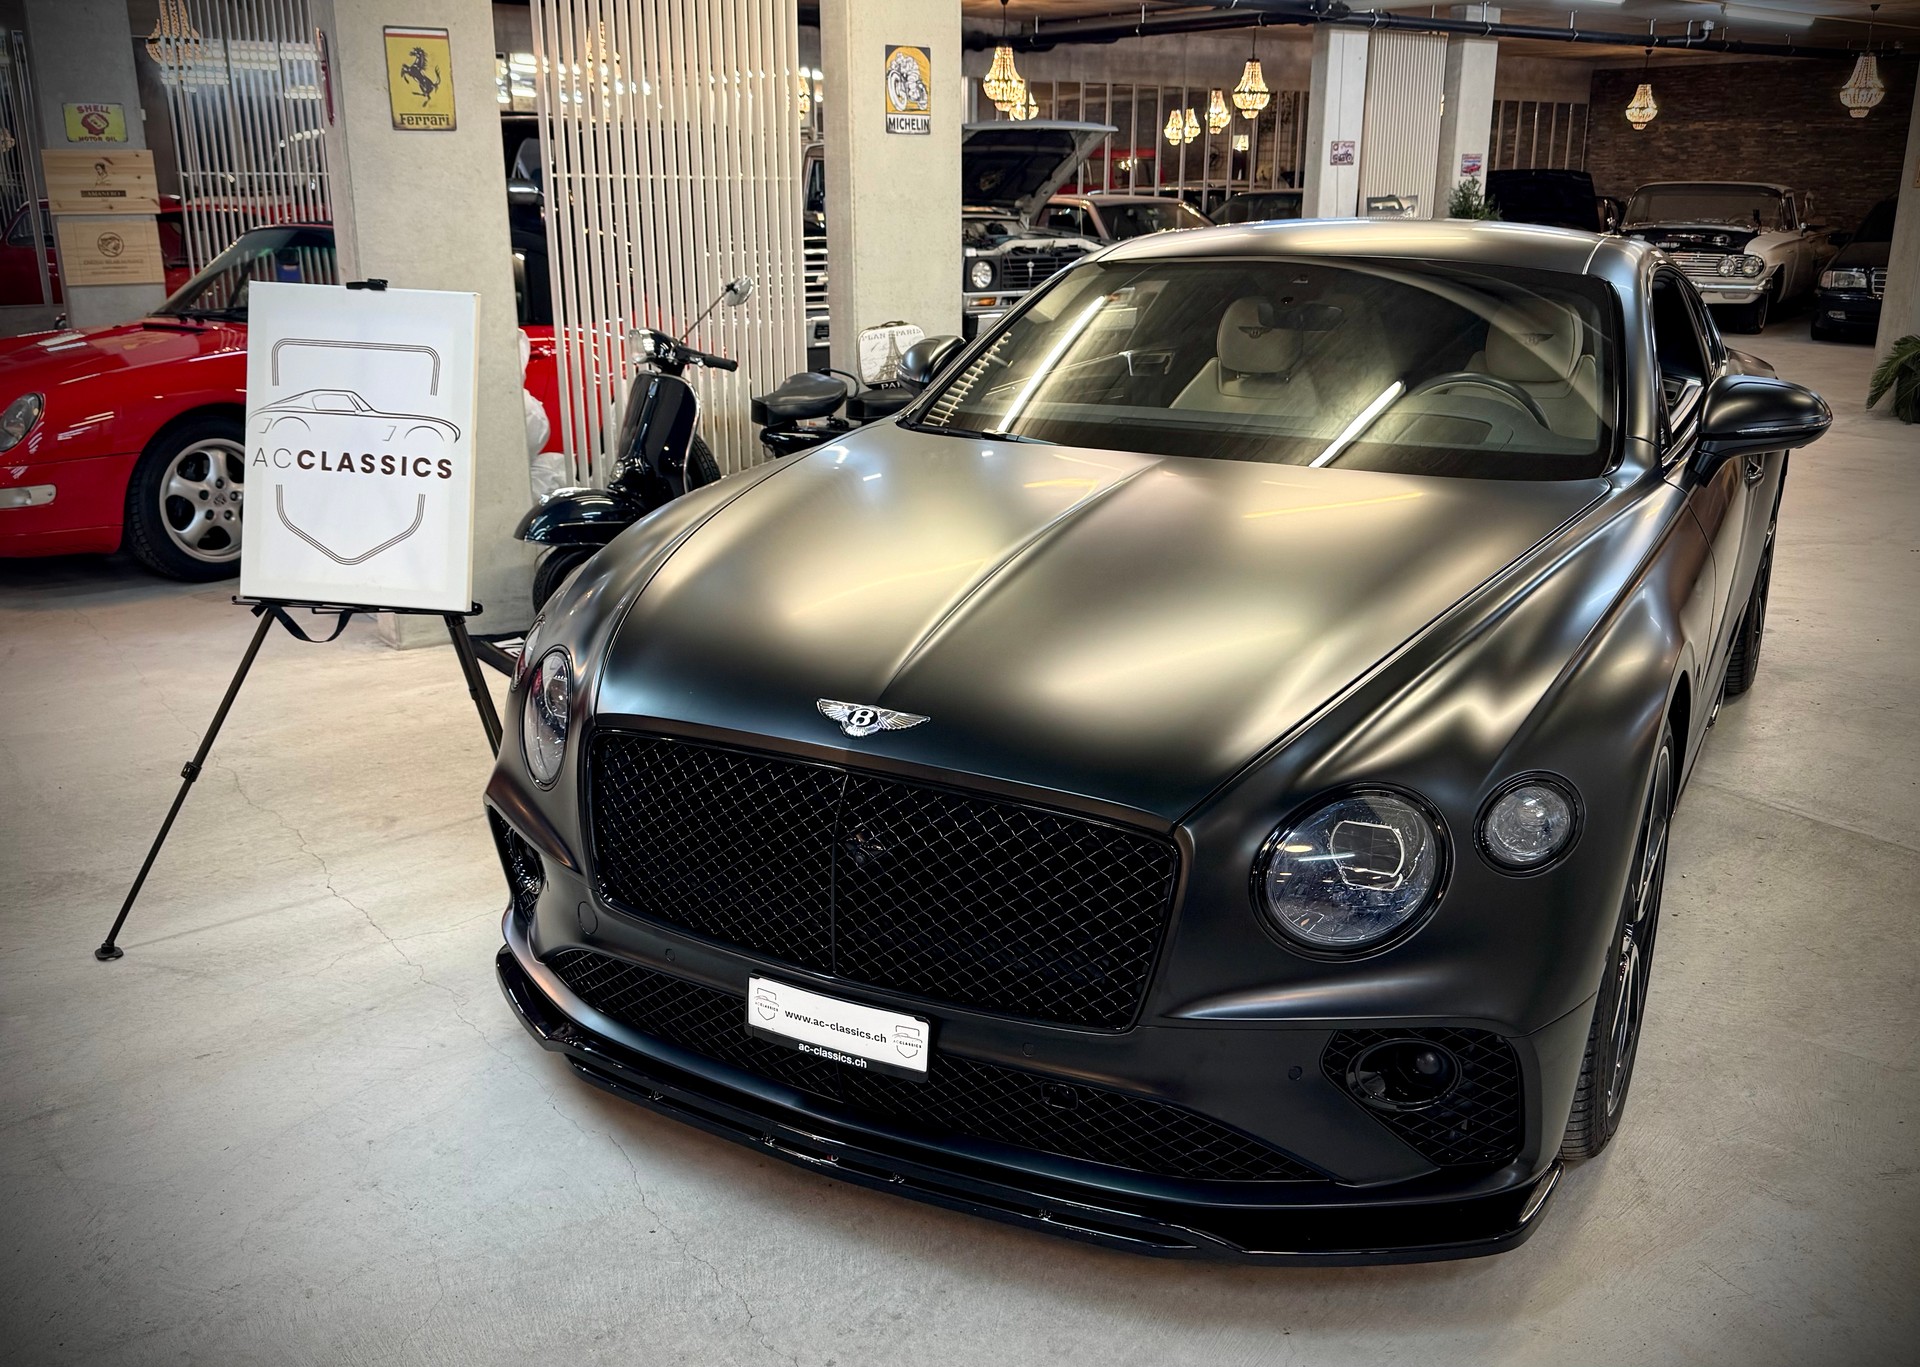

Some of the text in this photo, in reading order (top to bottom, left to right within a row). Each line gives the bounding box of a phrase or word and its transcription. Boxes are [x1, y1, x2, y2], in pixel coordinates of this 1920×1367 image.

[76, 105, 111, 114] SHELL
[399, 113, 450, 126] Ferrari
[888, 117, 930, 131] MICHELIN
[784, 1009, 887, 1043] www.ac-classics.ch
[798, 1042, 868, 1069] ac-classics.ch
